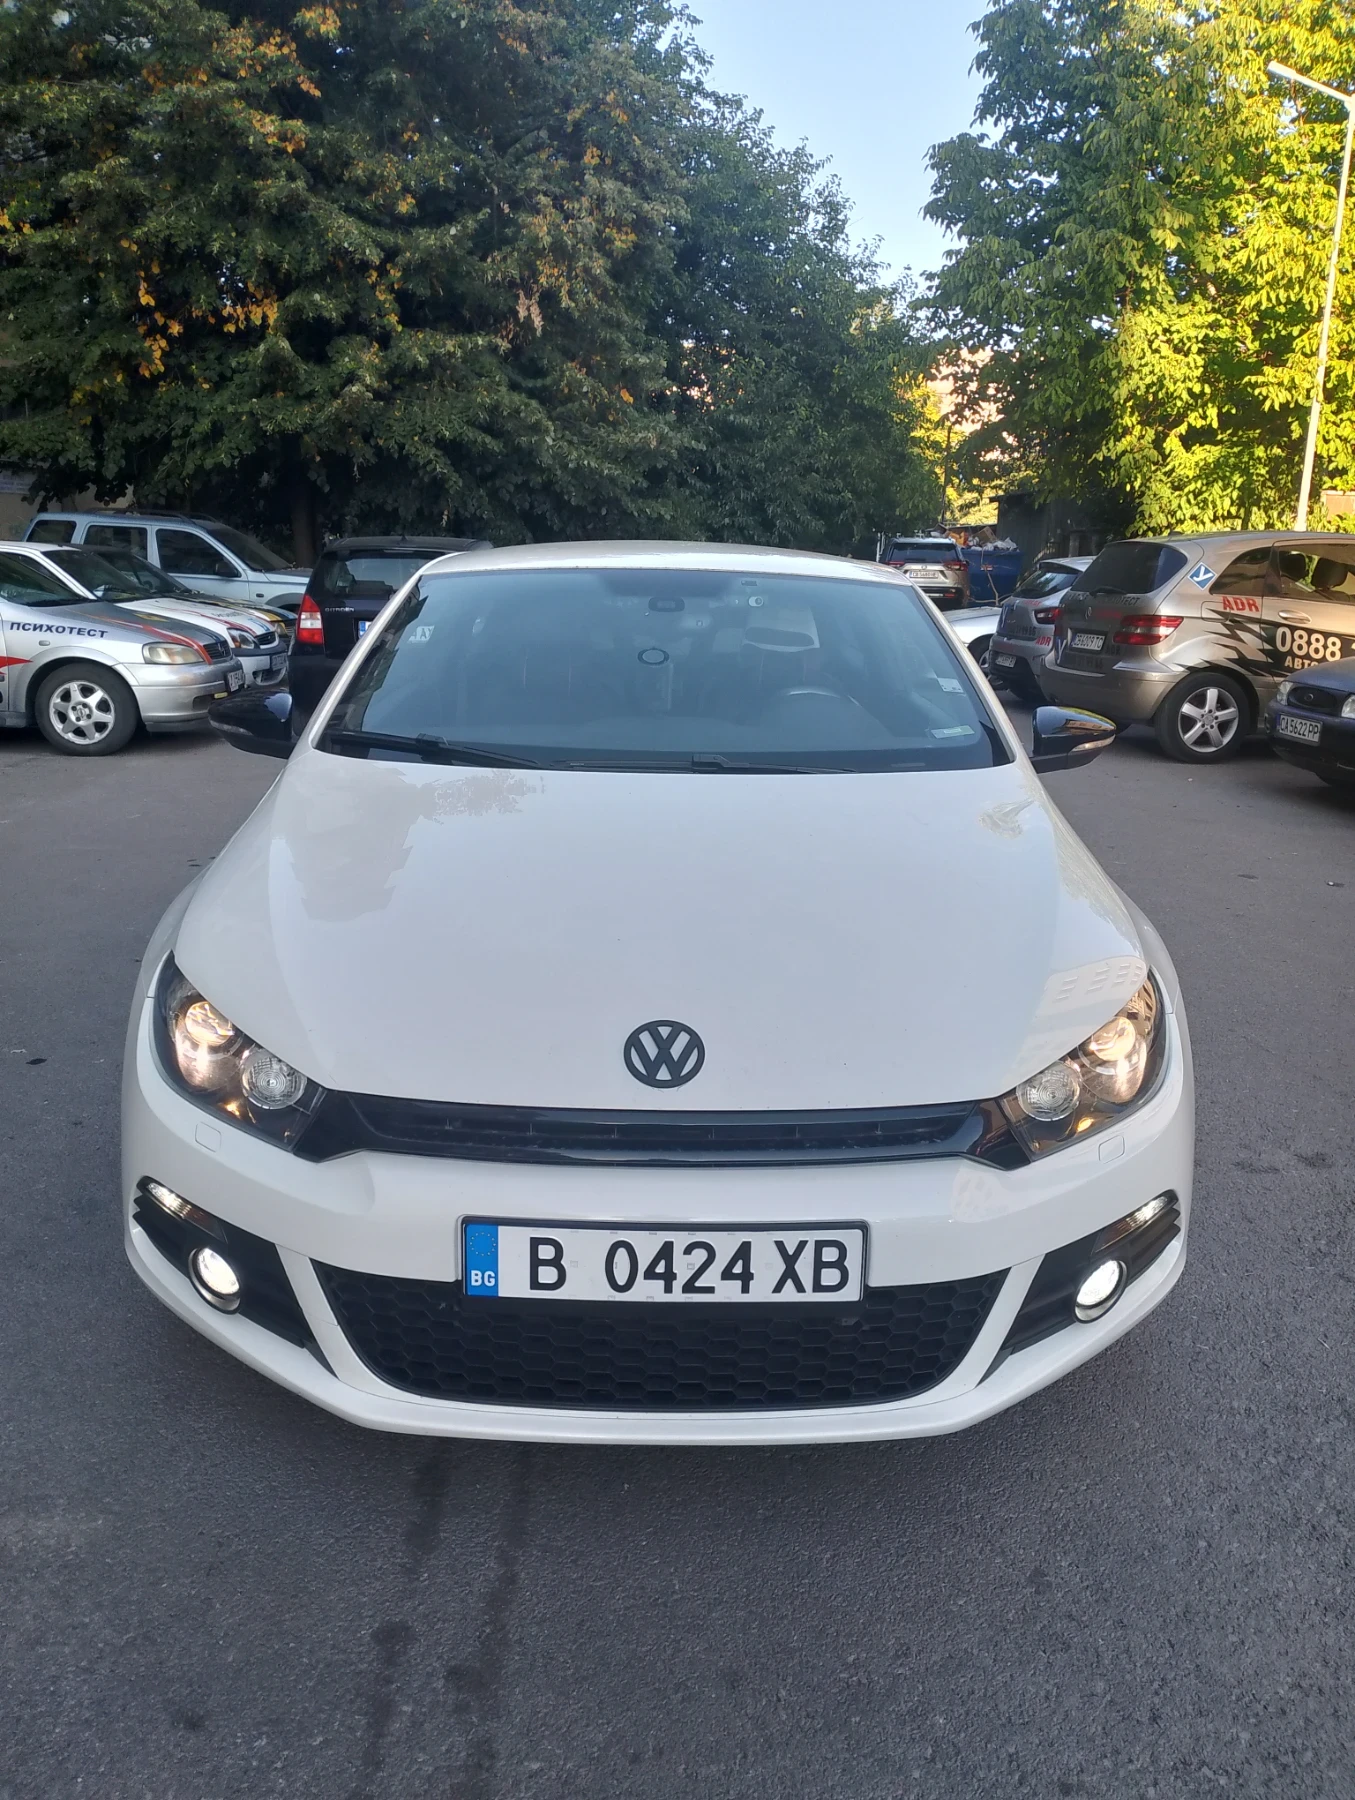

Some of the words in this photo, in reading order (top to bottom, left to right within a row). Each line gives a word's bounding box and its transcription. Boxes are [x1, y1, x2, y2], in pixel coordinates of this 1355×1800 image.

[1223, 596, 1260, 613] ADR
[10, 622, 108, 638] ПСИХОТЕСТ
[1275, 626, 1342, 662] 0888
[471, 1270, 495, 1286] BG
